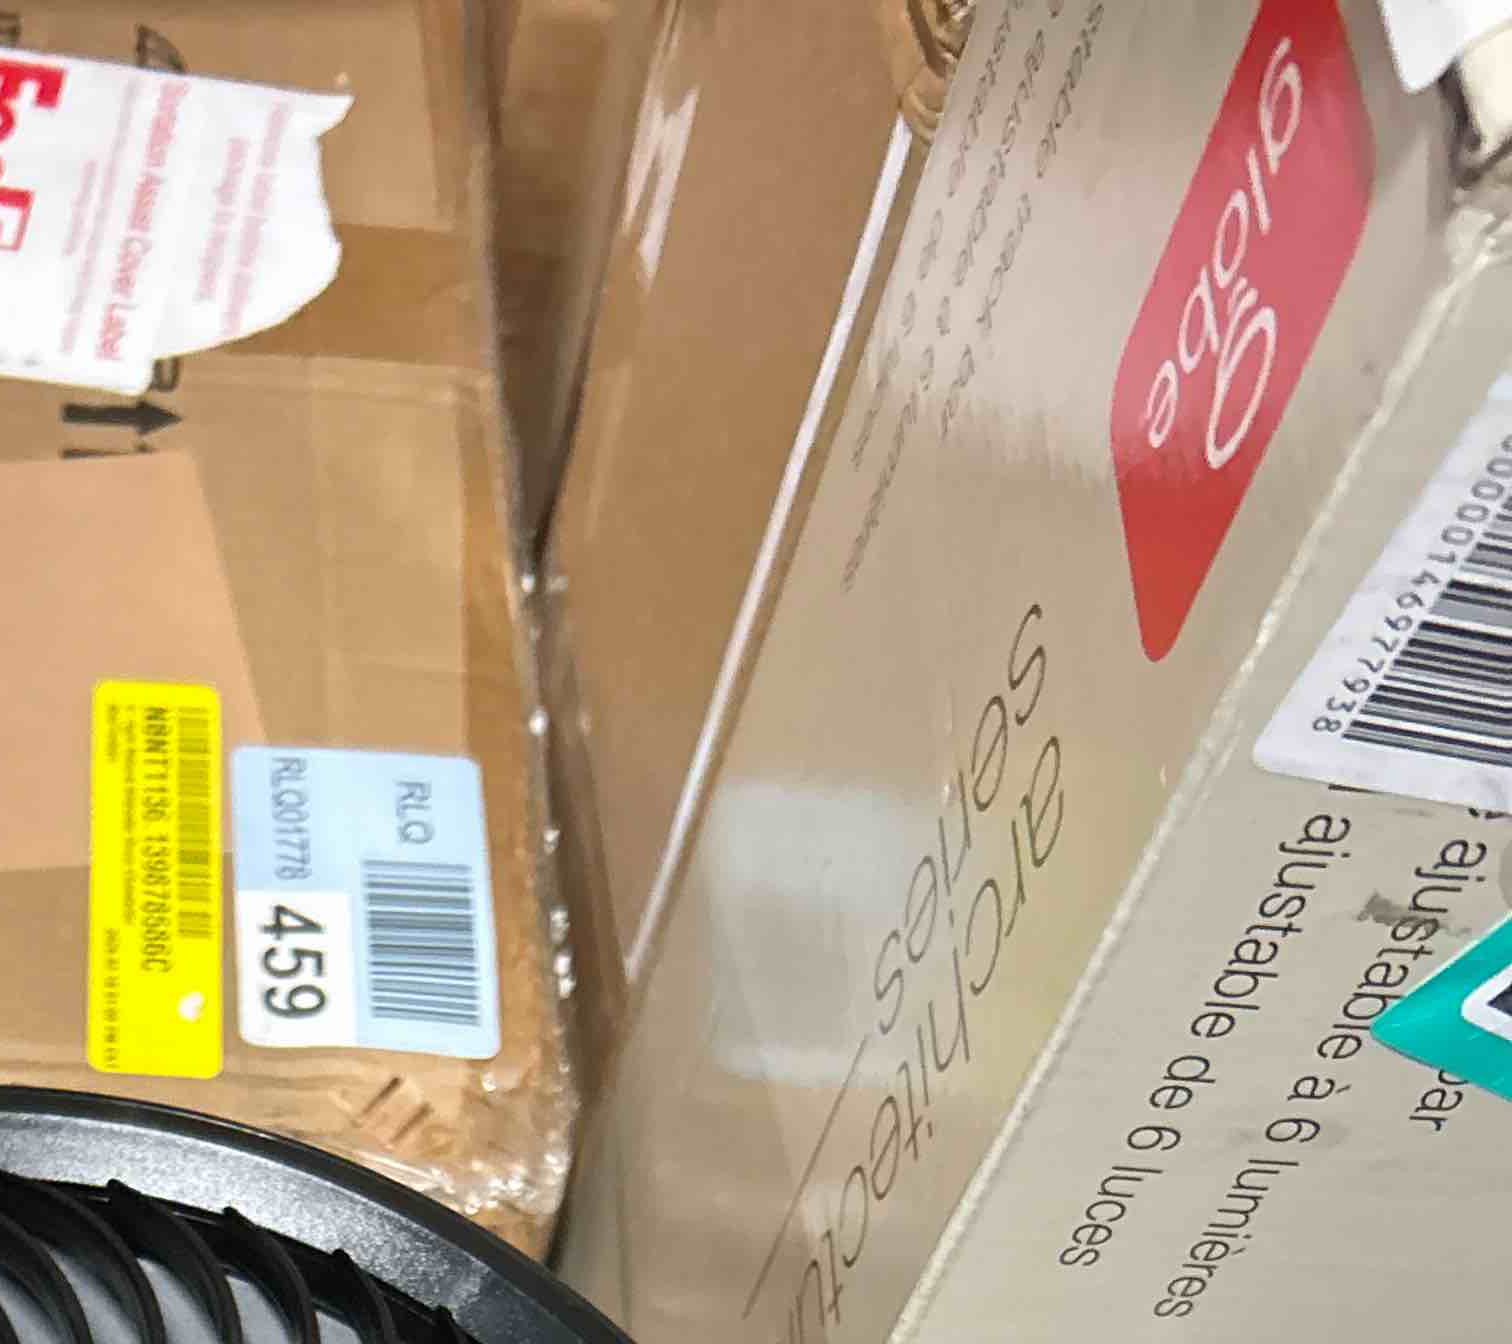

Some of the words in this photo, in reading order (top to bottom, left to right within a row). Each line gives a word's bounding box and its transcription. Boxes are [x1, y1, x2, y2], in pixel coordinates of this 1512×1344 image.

[1142, 37, 1302, 449] globe
[1312, 432, 1512, 735] 0000146977938
[395, 779, 435, 847] RLQ
[874, 603, 1047, 1036] series
[259, 904, 329, 1020] 459
[1191, 813, 1351, 1040] ajustable
[1317, 838, 1488, 1061] ajustable
[1128, 1124, 1181, 1153] 6
[1148, 1054, 1215, 1111] de
[1265, 1116, 1321, 1145] 6
[1287, 1074, 1351, 1101] à
[1059, 1164, 1163, 1269] luces
[1153, 1158, 1300, 1319] lumières
